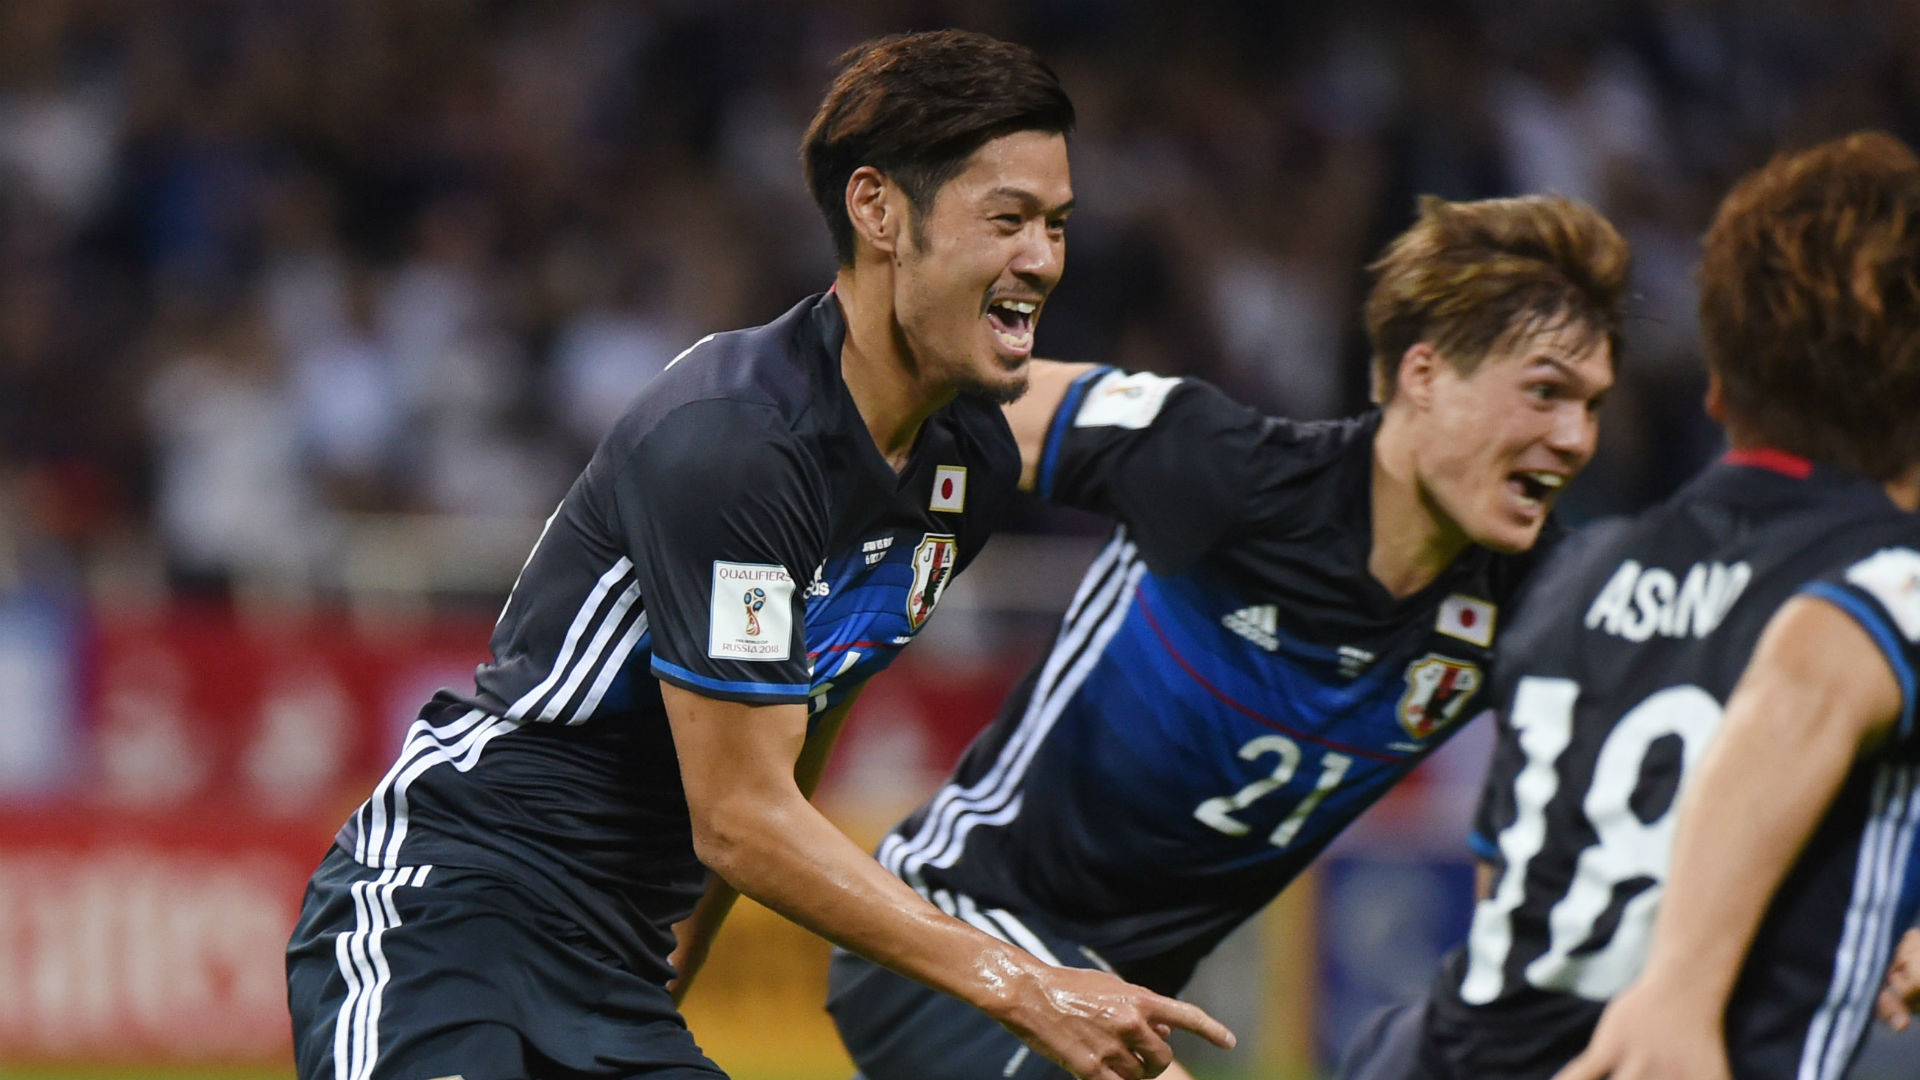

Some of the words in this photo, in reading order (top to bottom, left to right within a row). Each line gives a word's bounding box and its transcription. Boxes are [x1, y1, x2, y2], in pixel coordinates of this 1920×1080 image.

[719, 567, 793, 582] QUALIFIERS
[1584, 559, 1752, 643] ASN
[722, 643, 758, 654] RUSSIA
[1193, 735, 1353, 848] 21
[1459, 674, 1726, 1006] 18
